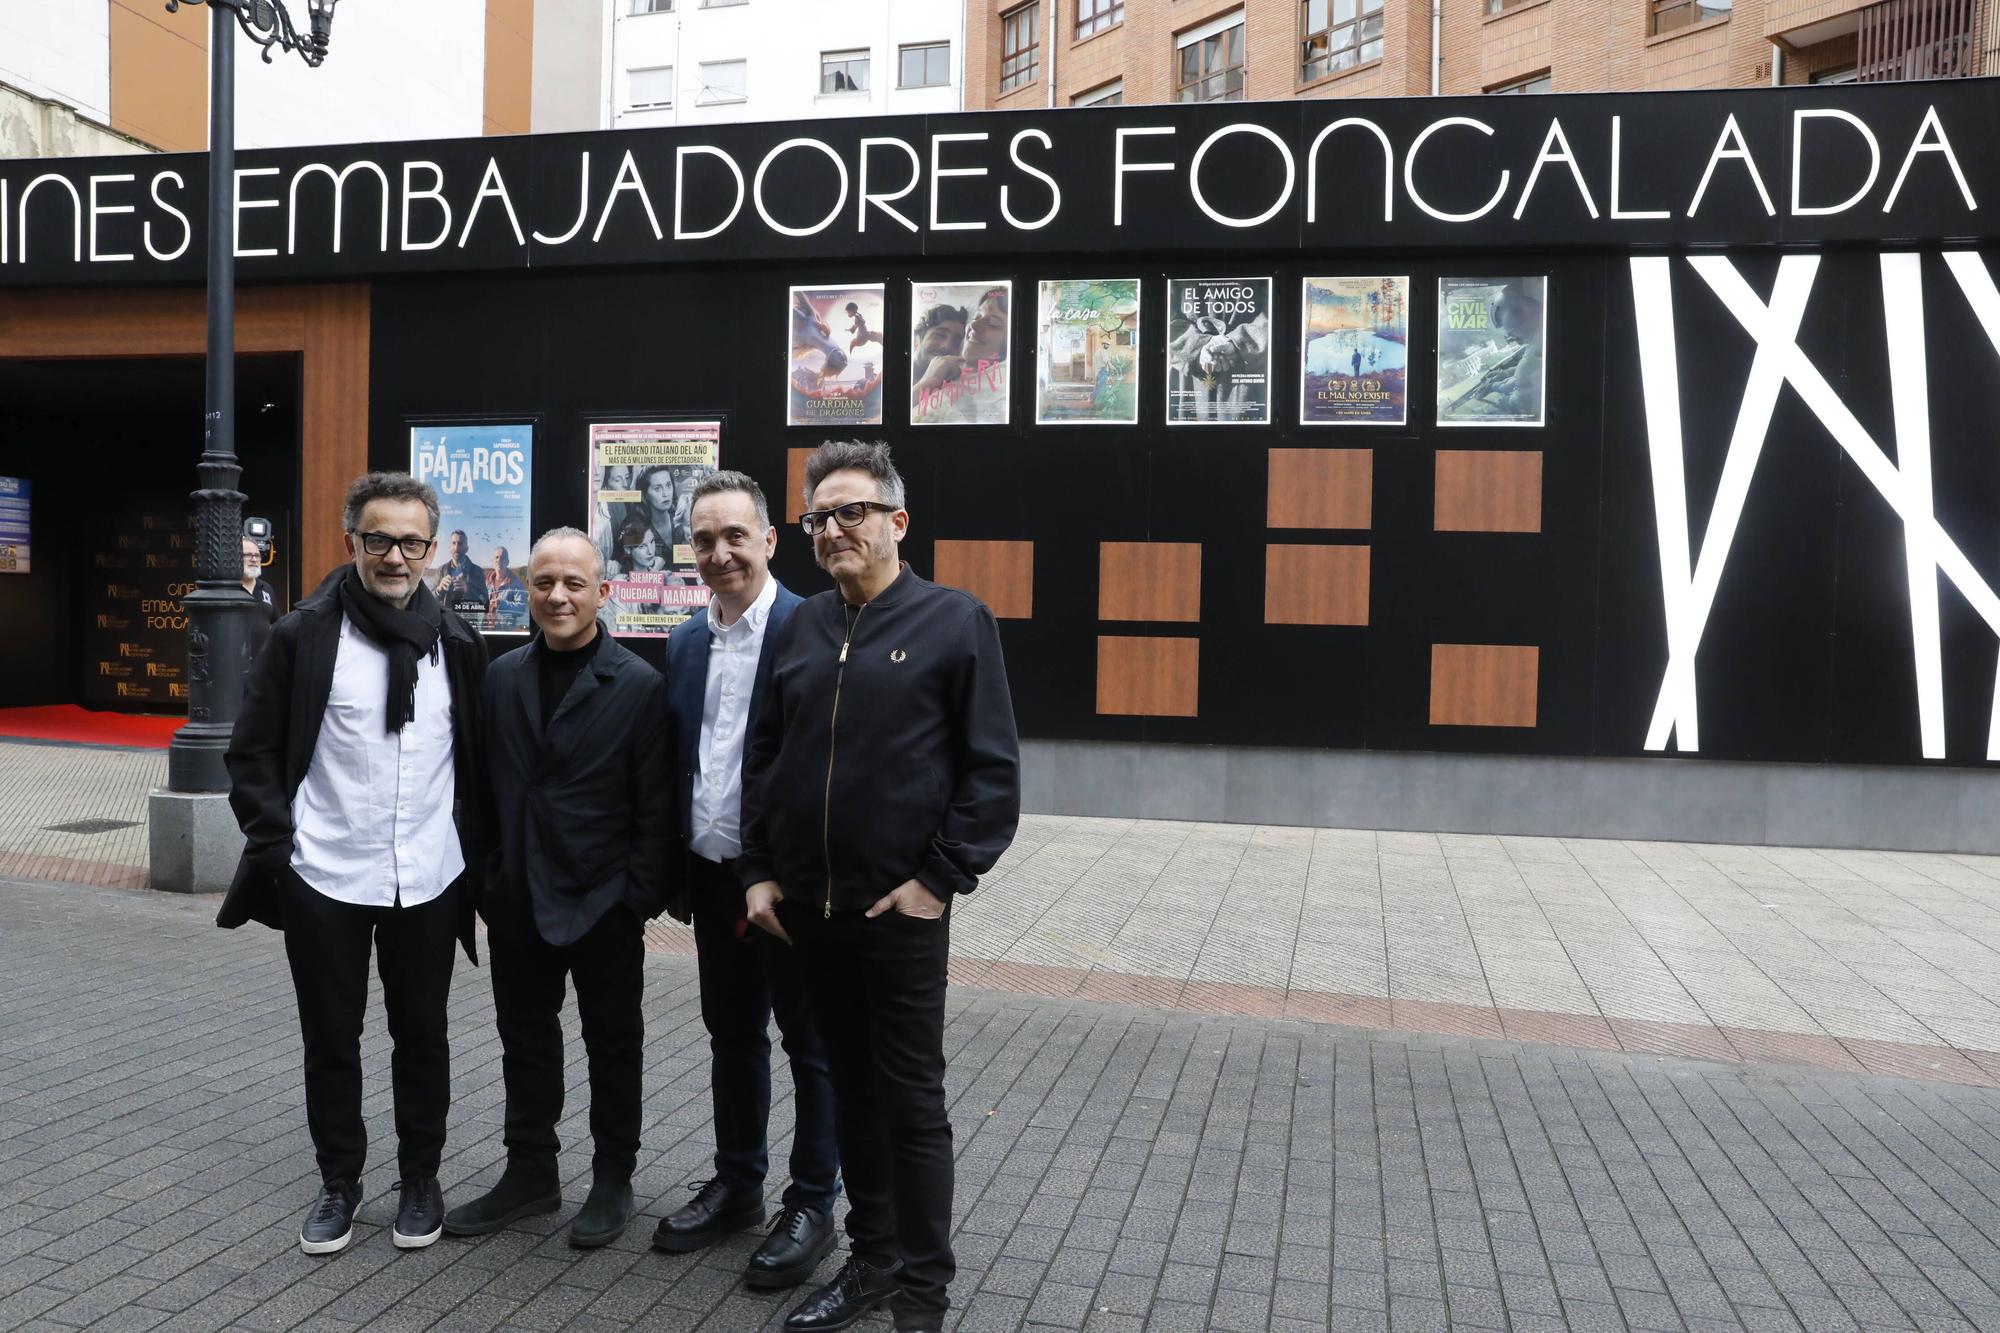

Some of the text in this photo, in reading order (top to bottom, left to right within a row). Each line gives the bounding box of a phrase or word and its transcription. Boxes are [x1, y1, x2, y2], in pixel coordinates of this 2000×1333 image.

[234, 128, 1060, 257] EMBAJADORES
[1113, 102, 1977, 227] FONCALADA
[1184, 287, 1254, 300] EL AMIGO
[1183, 301, 1256, 314] DE TODOS
[1447, 302, 1488, 315] CIVIL
[1447, 315, 1489, 329] WAR
[1318, 392, 1391, 401] EL MAL NO EXISTE
[806, 399, 864, 409] GUARDIANA
[819, 408, 865, 417] DRAGONES
[604, 445, 613, 455] EL
[650, 445, 679, 455] ITALIANO
[680, 445, 692, 454] DEL
[693, 443, 707, 455] AÑO
[419, 437, 524, 495] PÁJAROS
[630, 572, 663, 584] SIEMPRE
[620, 586, 658, 601] QUEDARÁ
[663, 587, 708, 605] MAÑANA
